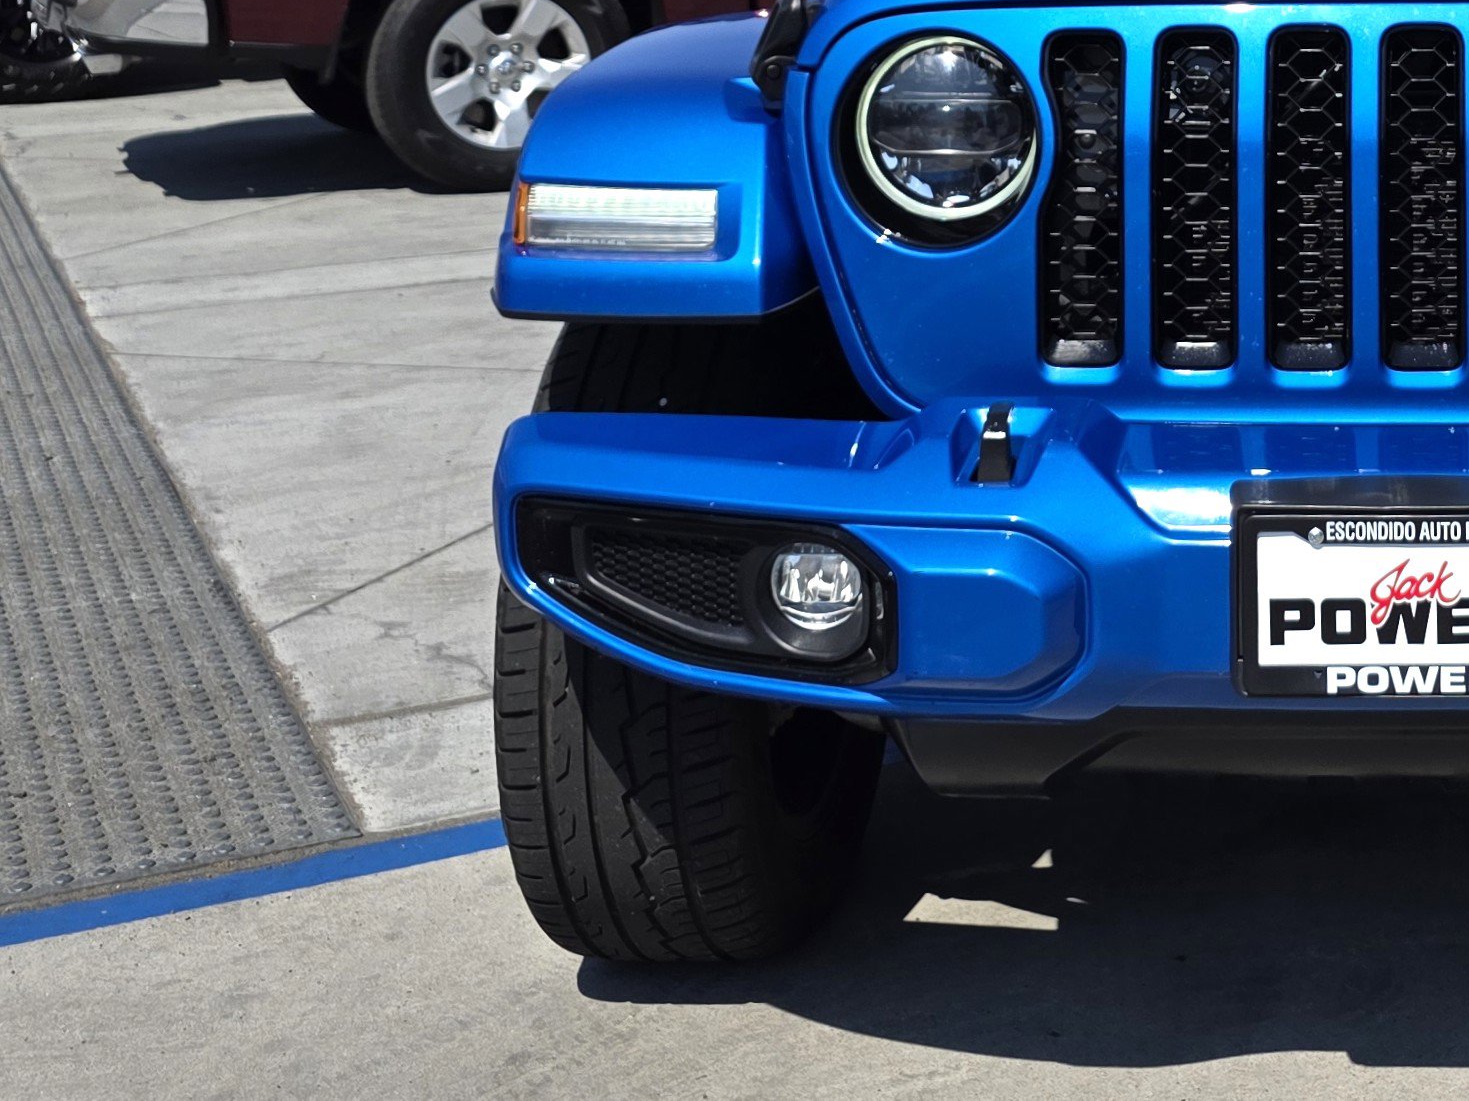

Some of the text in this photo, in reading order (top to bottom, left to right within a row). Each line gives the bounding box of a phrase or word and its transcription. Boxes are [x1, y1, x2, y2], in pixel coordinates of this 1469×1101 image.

[1326, 520, 1415, 542] ESCONDIDO
[1419, 520, 1463, 541] AUTO
[1370, 558, 1461, 626] Jack
